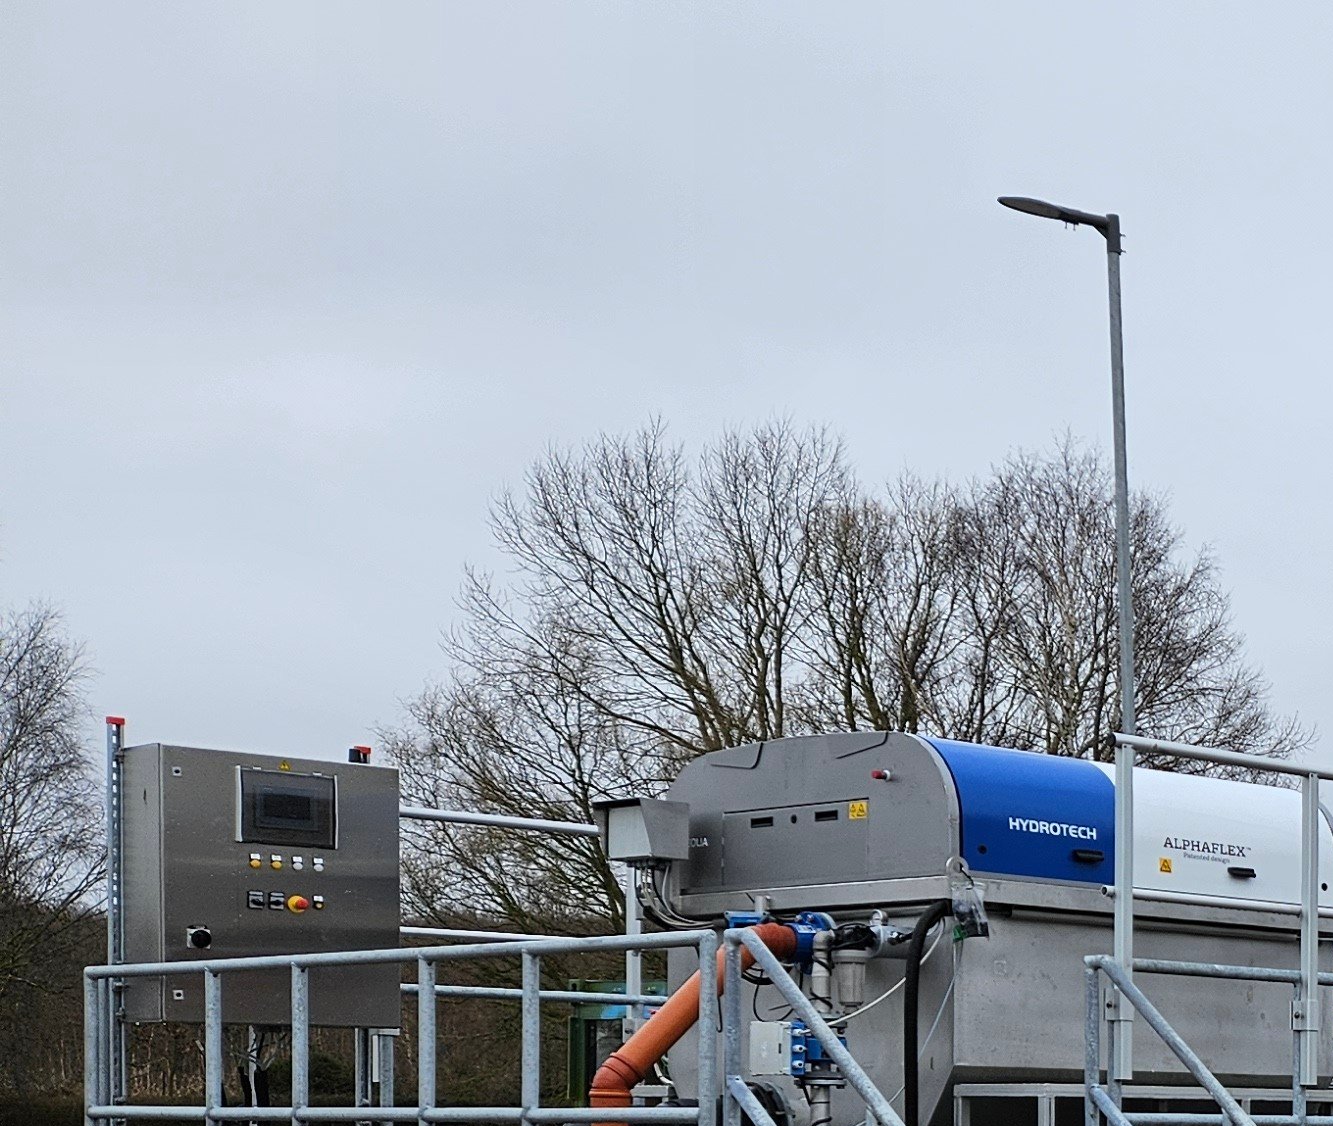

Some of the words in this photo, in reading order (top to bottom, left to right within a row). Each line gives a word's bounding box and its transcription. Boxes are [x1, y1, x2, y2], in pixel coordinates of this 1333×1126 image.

[1008, 816, 1097, 841] HYDROTECH
[1183, 852, 1210, 862] Patented
[1211, 856, 1231, 865] design
